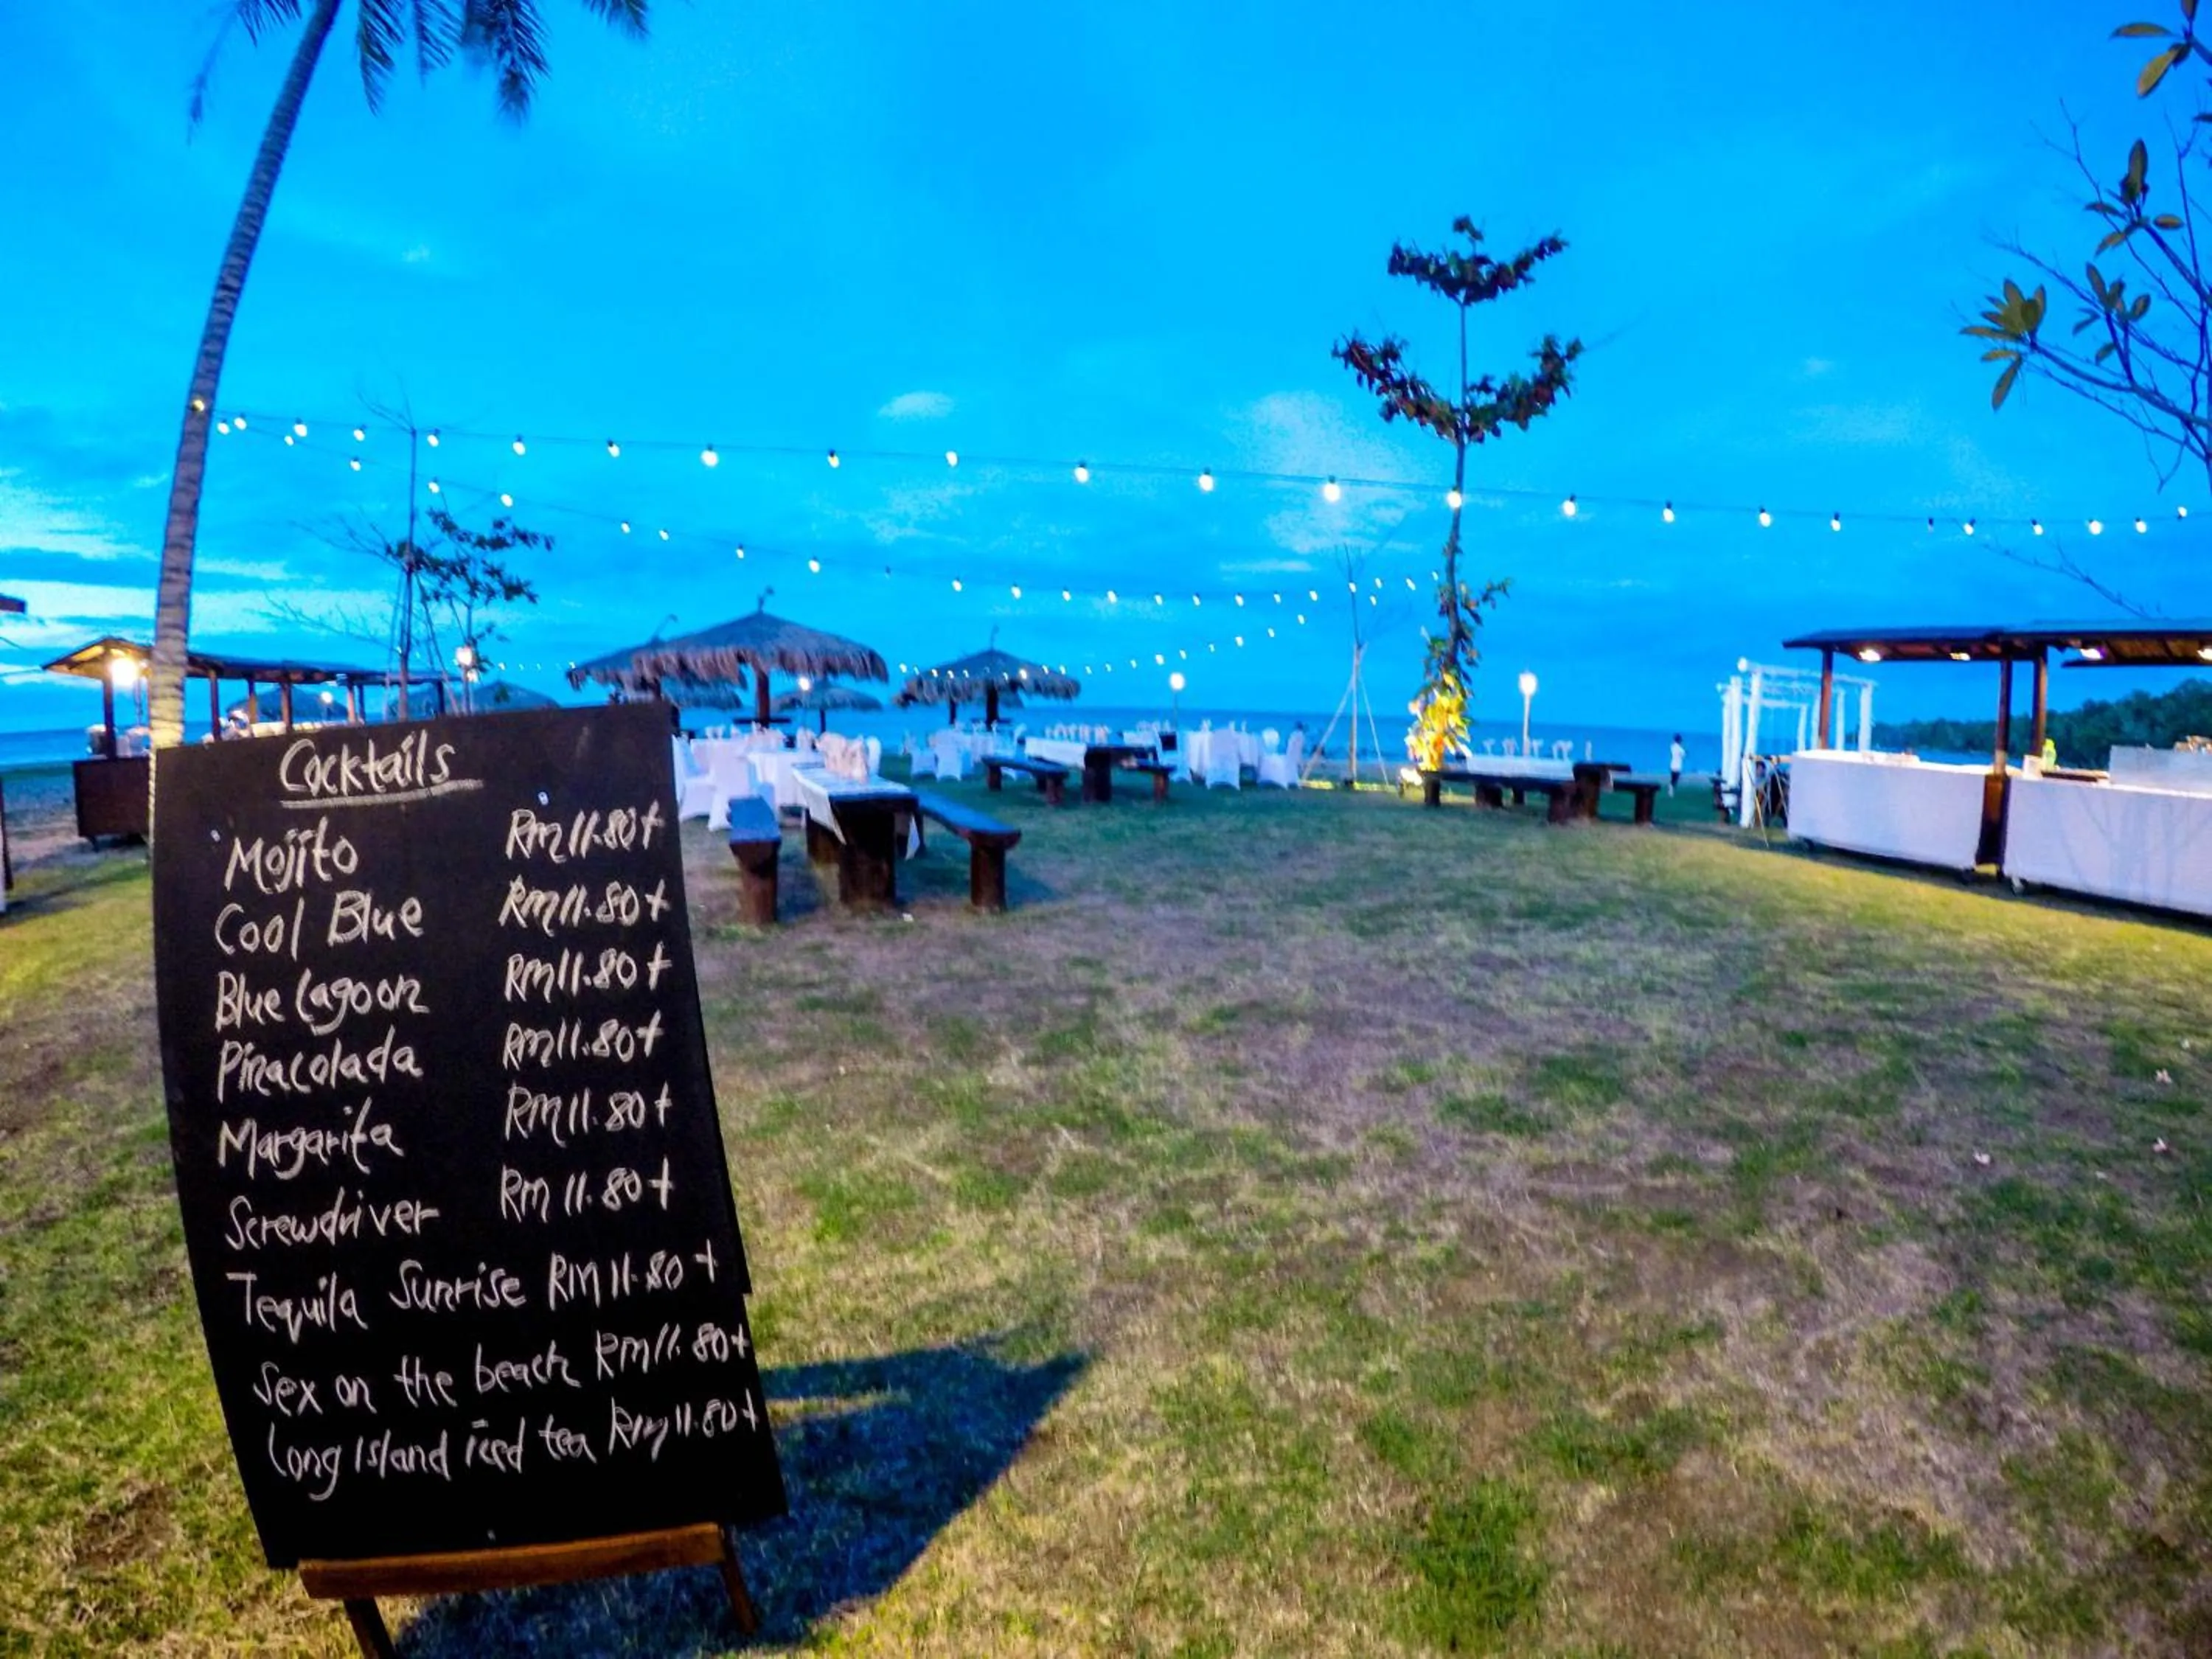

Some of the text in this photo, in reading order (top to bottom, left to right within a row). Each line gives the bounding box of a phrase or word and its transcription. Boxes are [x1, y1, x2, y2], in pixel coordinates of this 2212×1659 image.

[279, 728, 456, 797] Cocktails
[223, 815, 359, 894] Mojito
[215, 895, 305, 962] Cool
[327, 889, 425, 947] Blue
[215, 970, 286, 1032] Blue
[295, 967, 430, 1036] Lagoon
[217, 1023, 425, 1105] Pinacolada
[217, 1096, 405, 1180] Margarita
[225, 1185, 440, 1251] Screwdriver
[225, 1270, 369, 1345] Tequila
[389, 1259, 529, 1313] Sunrise
[252, 1360, 324, 1417] Sex
[335, 1373, 378, 1415] on
[392, 1354, 459, 1408] the
[474, 1339, 582, 1395] beach
[465, 1416, 526, 1475] iced
[538, 1413, 598, 1464] tea
